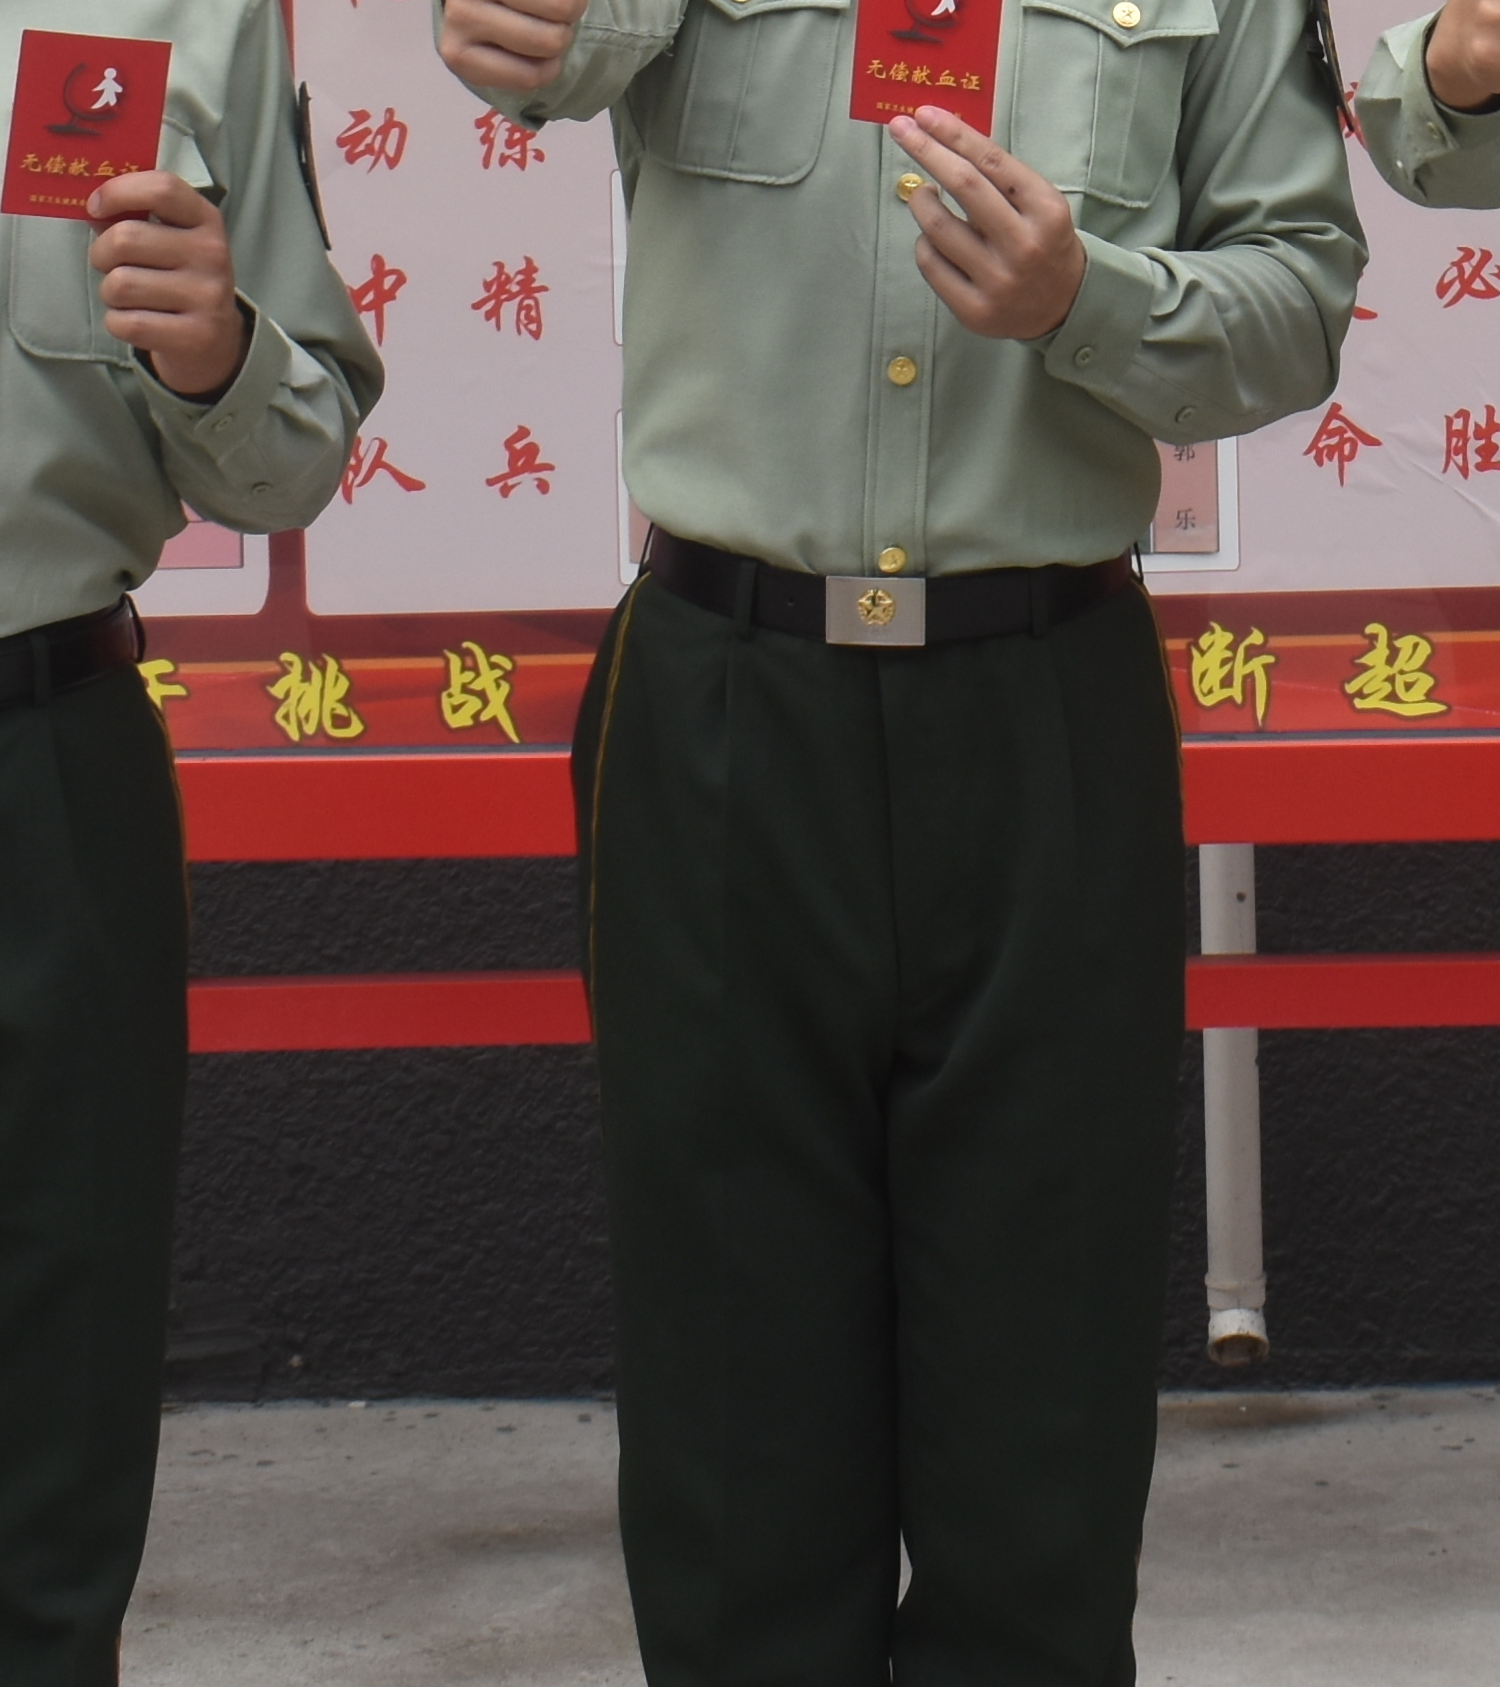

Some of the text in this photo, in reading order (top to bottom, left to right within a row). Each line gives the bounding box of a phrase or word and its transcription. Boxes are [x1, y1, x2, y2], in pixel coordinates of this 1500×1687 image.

[866, 59, 981, 91] 无偿献血证
